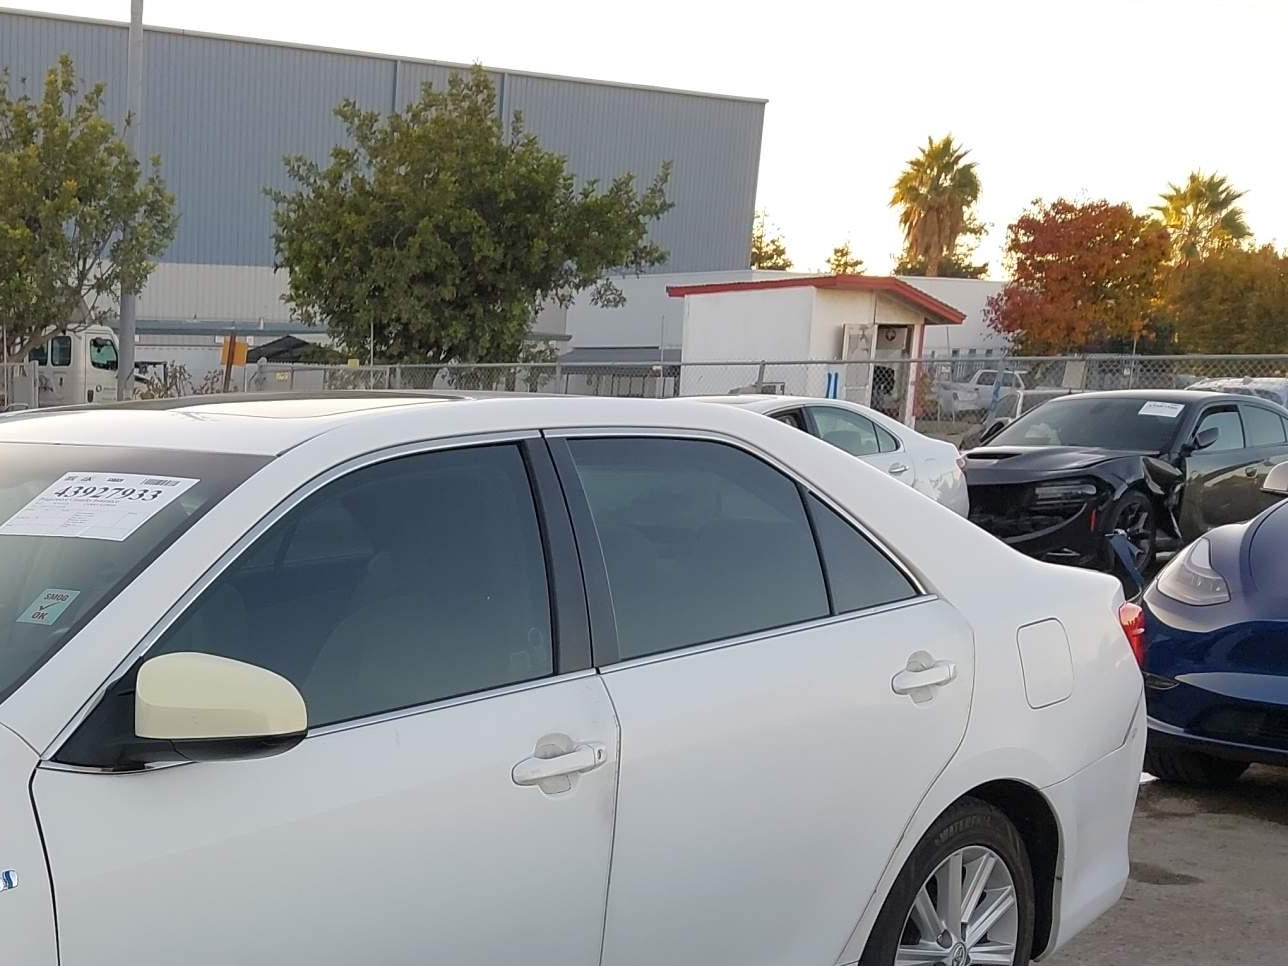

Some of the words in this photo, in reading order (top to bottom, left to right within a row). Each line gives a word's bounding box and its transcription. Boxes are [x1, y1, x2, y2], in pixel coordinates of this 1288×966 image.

[55, 486, 163, 501] 43927933
[43, 593, 70, 602] SMOG
[32, 611, 48, 620] OK
